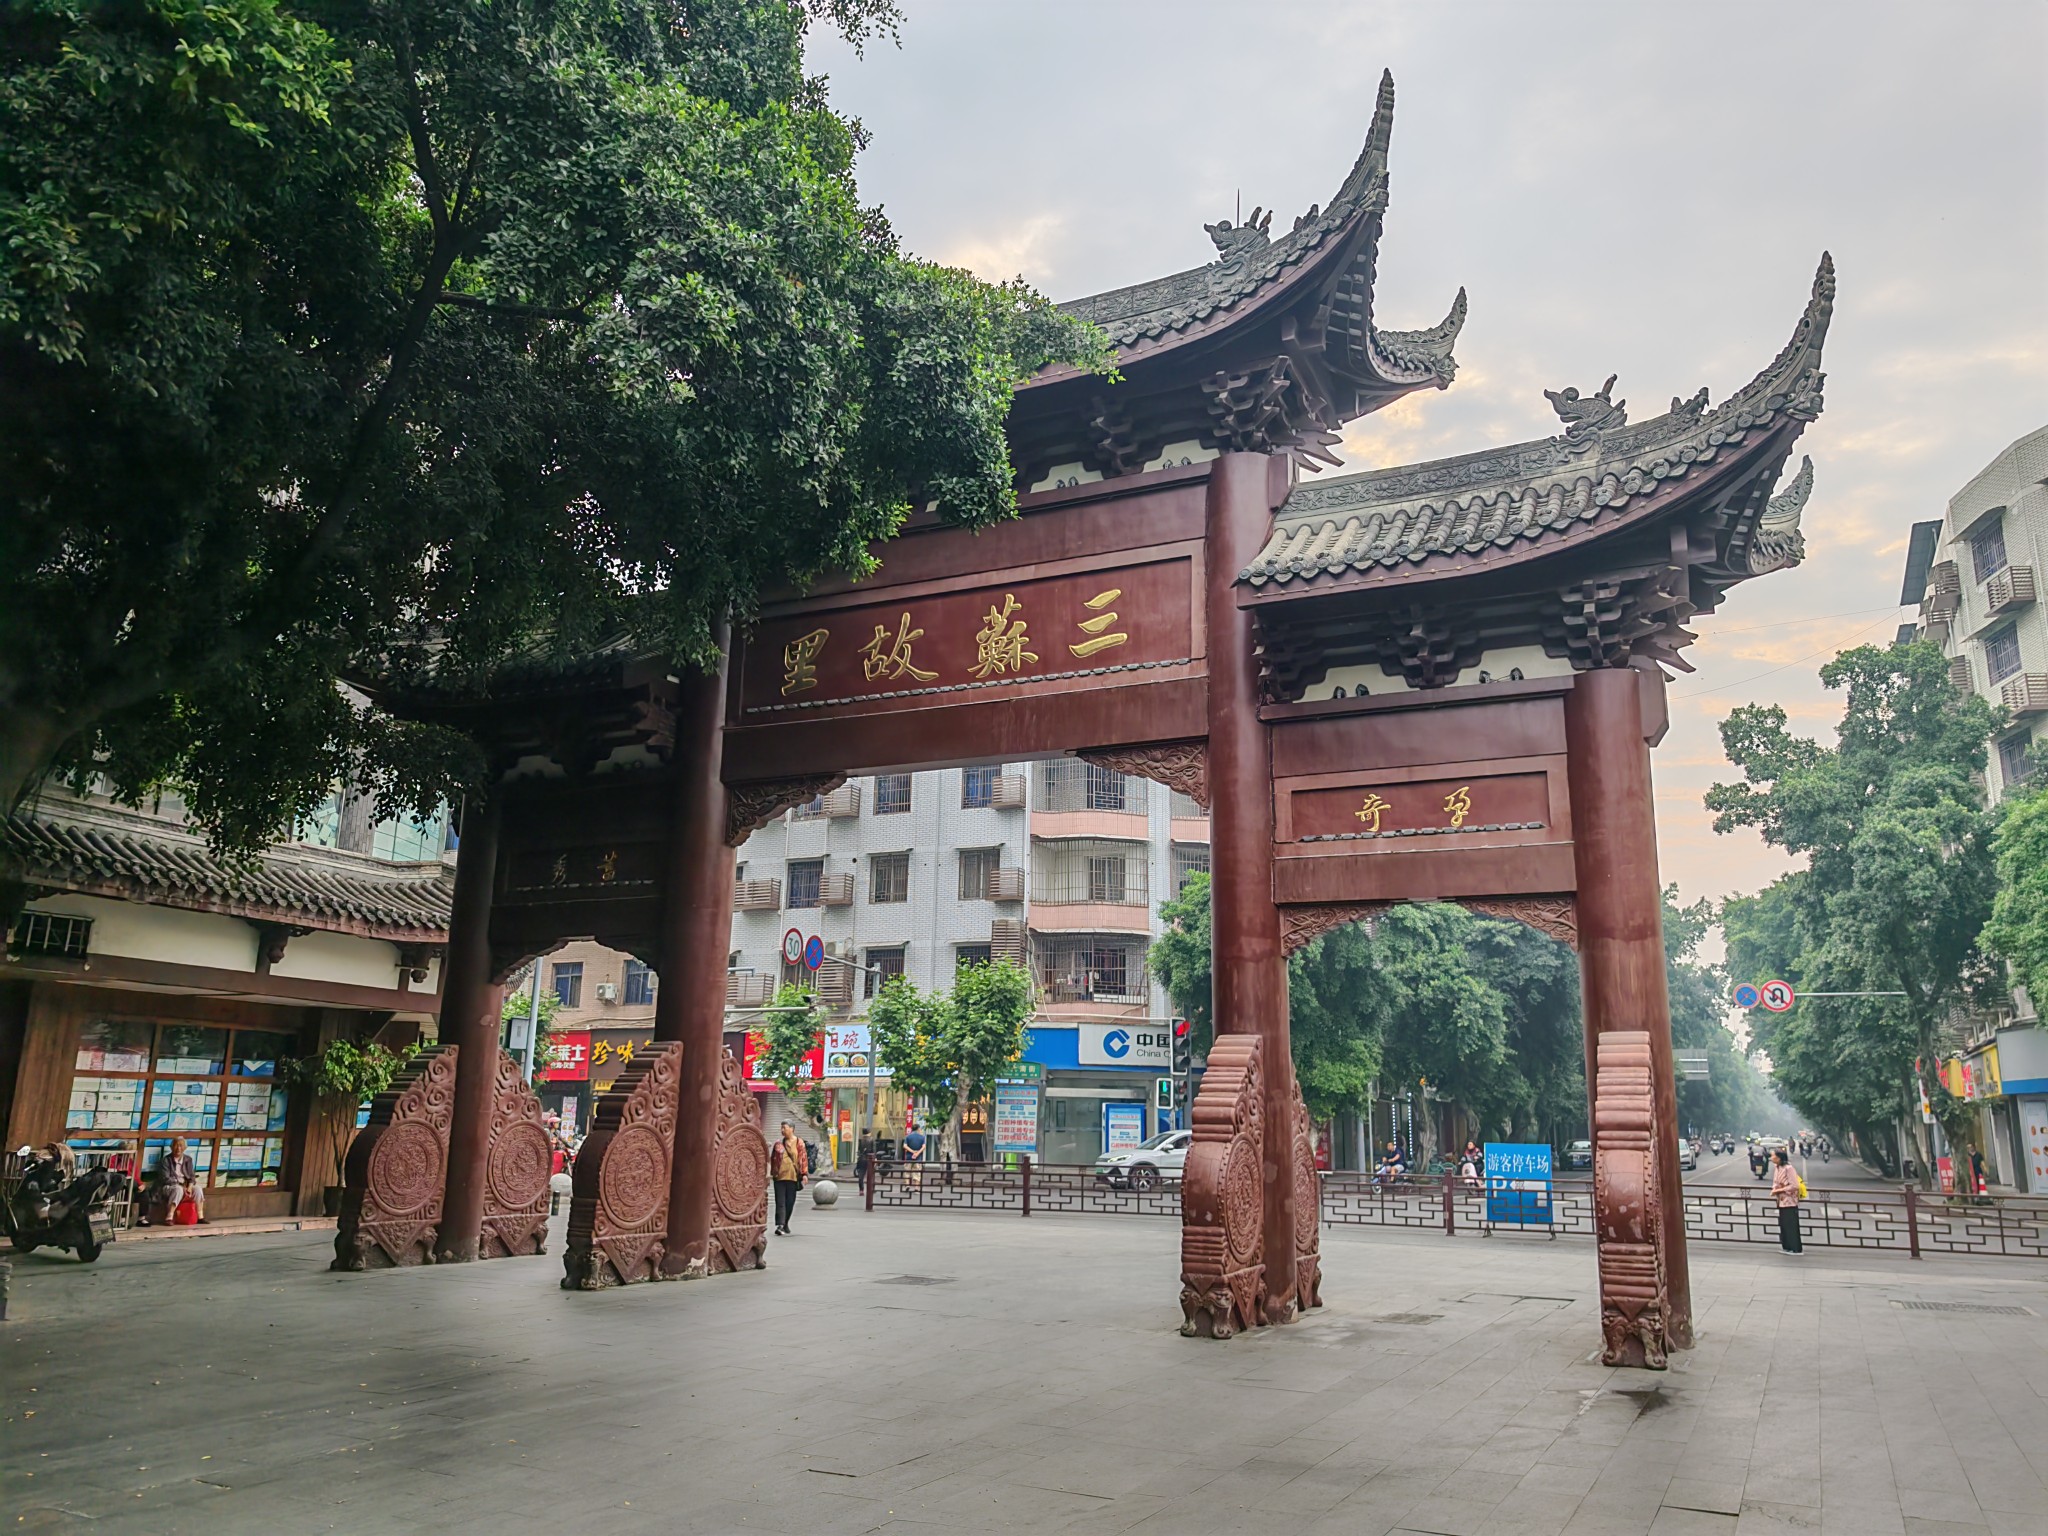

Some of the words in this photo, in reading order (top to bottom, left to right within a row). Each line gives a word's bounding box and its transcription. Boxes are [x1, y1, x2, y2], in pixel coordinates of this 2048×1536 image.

[787, 937, 800, 957] 30
[1136, 1049, 1162, 1058] China
[1488, 1153, 1549, 1174] 游客停车场
